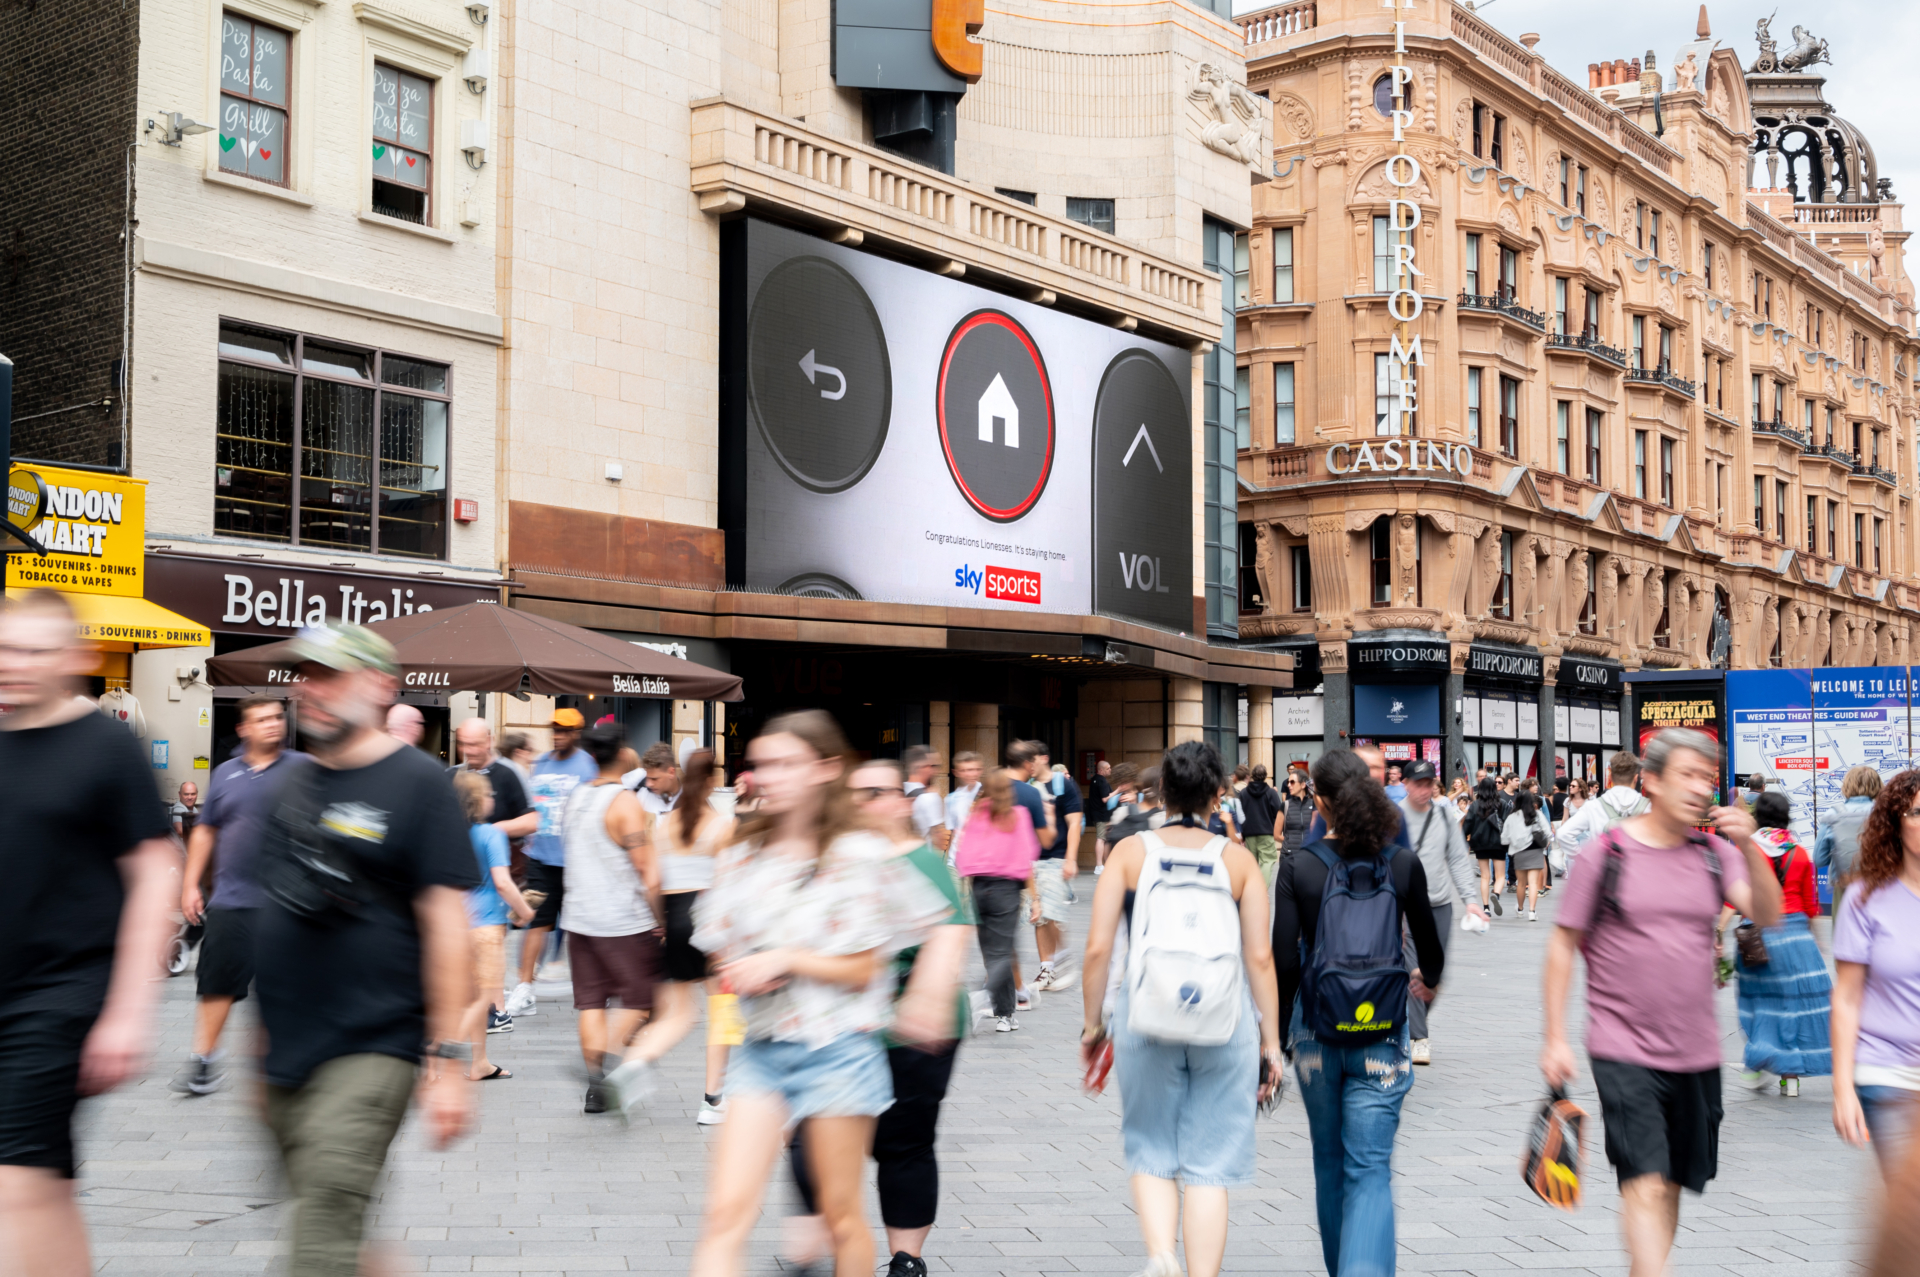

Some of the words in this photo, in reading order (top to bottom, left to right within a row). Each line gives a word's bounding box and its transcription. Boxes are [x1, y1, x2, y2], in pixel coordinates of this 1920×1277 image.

[223, 19, 277, 61] Pizza
[221, 54, 273, 91] Pasta
[374, 69, 421, 108] Pizza
[225, 103, 274, 136] Grill
[373, 103, 418, 137] Pasta
[1382, 0, 1427, 411] IPPODROME
[1326, 439, 1473, 476] CASINO
[8, 485, 38, 506] ONDON
[45, 484, 123, 524] NDON
[29, 520, 107, 557] MART
[925, 530, 979, 548] Congratulations
[980, 539, 1014, 553] Lionesses.
[1014, 545, 1024, 555] It's
[1025, 547, 1048, 561] staying
[6, 555, 23, 566] FTS
[32, 557, 91, 572] SOUVENIRS
[100, 564, 137, 576] DRINKS
[1119, 552, 1169, 593] VOL
[19, 570, 68, 584] TOBACCO
[71, 575, 78, 584] &
[82, 576, 112, 588] VAPES
[955, 564, 983, 595] sky
[988, 573, 1038, 597] sports
[222, 574, 328, 629] Bella
[100, 627, 158, 639] SOUVENIRS
[166, 631, 202, 642] DRINKS
[1359, 648, 1447, 663] HIPPODROME
[1472, 651, 1539, 677] HIPPODROME
[405, 672, 450, 686] GRILL
[613, 675, 641, 693] Bella
[642, 676, 670, 695] Italia
[1576, 665, 1608, 685] CASINO
[1810, 680, 1864, 693] WELCOME
[1870, 680, 1883, 691] TO
[1287, 707, 1310, 715] Archive
[1294, 718, 1310, 727] Myth
[1641, 705, 1716, 720] SPECTACULAR
[1653, 719, 1681, 727] NIGHT
[1683, 718, 1704, 726] OUT!
[1787, 712, 1828, 720] THEATRES
[1834, 711, 1859, 719] GUIDE
